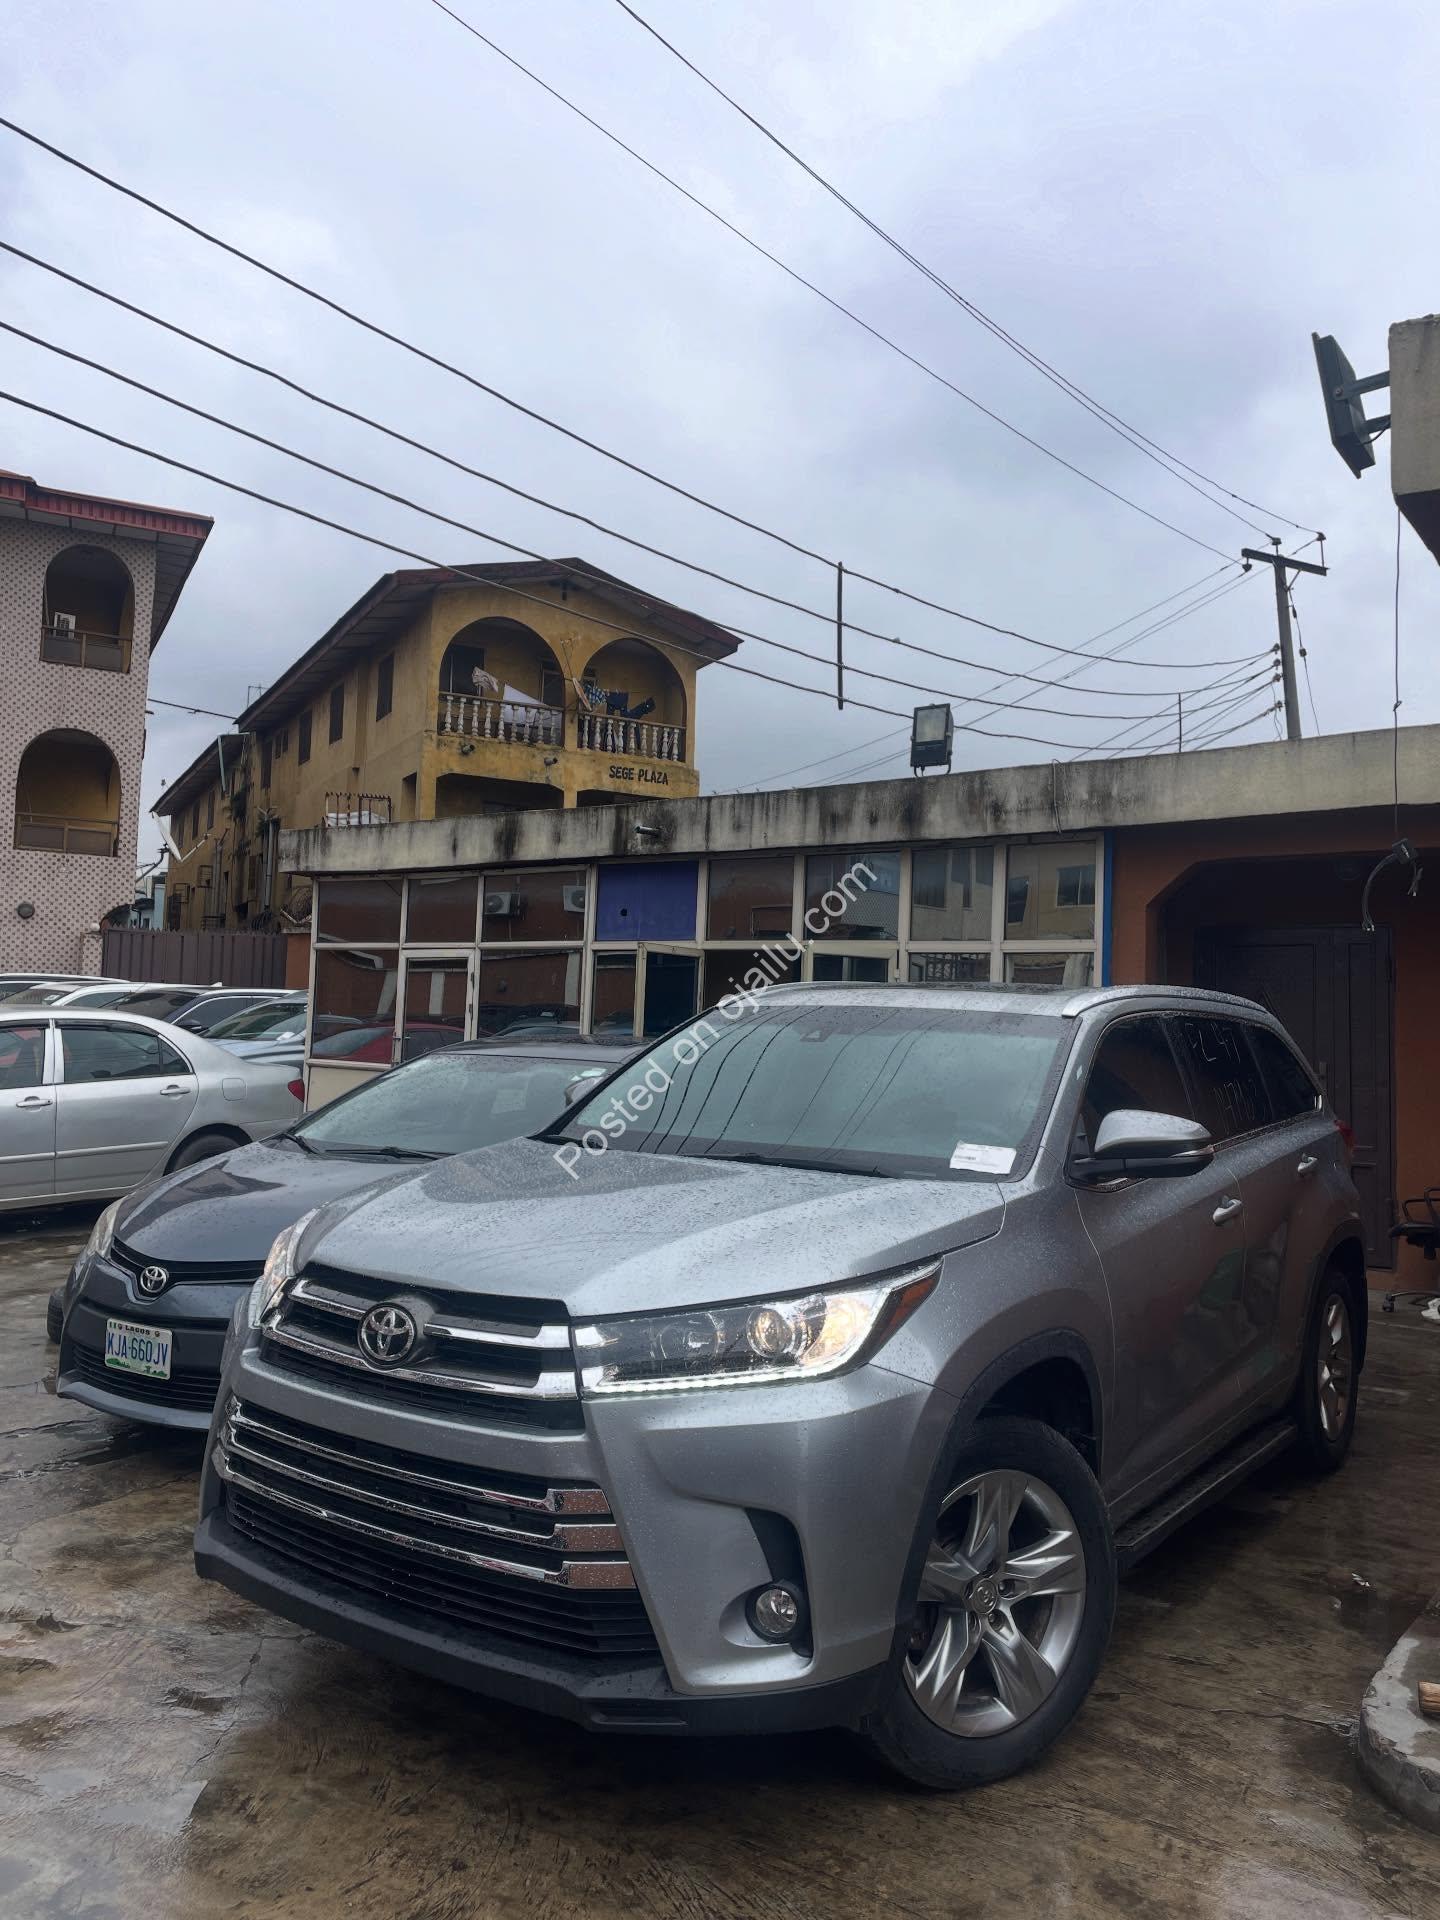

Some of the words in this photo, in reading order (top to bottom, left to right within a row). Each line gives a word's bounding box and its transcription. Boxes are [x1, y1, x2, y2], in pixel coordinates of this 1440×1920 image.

[608, 765, 635, 781] SEGE
[637, 767, 669, 786] PLAZA
[125, 1324, 151, 1336] LAGOS
